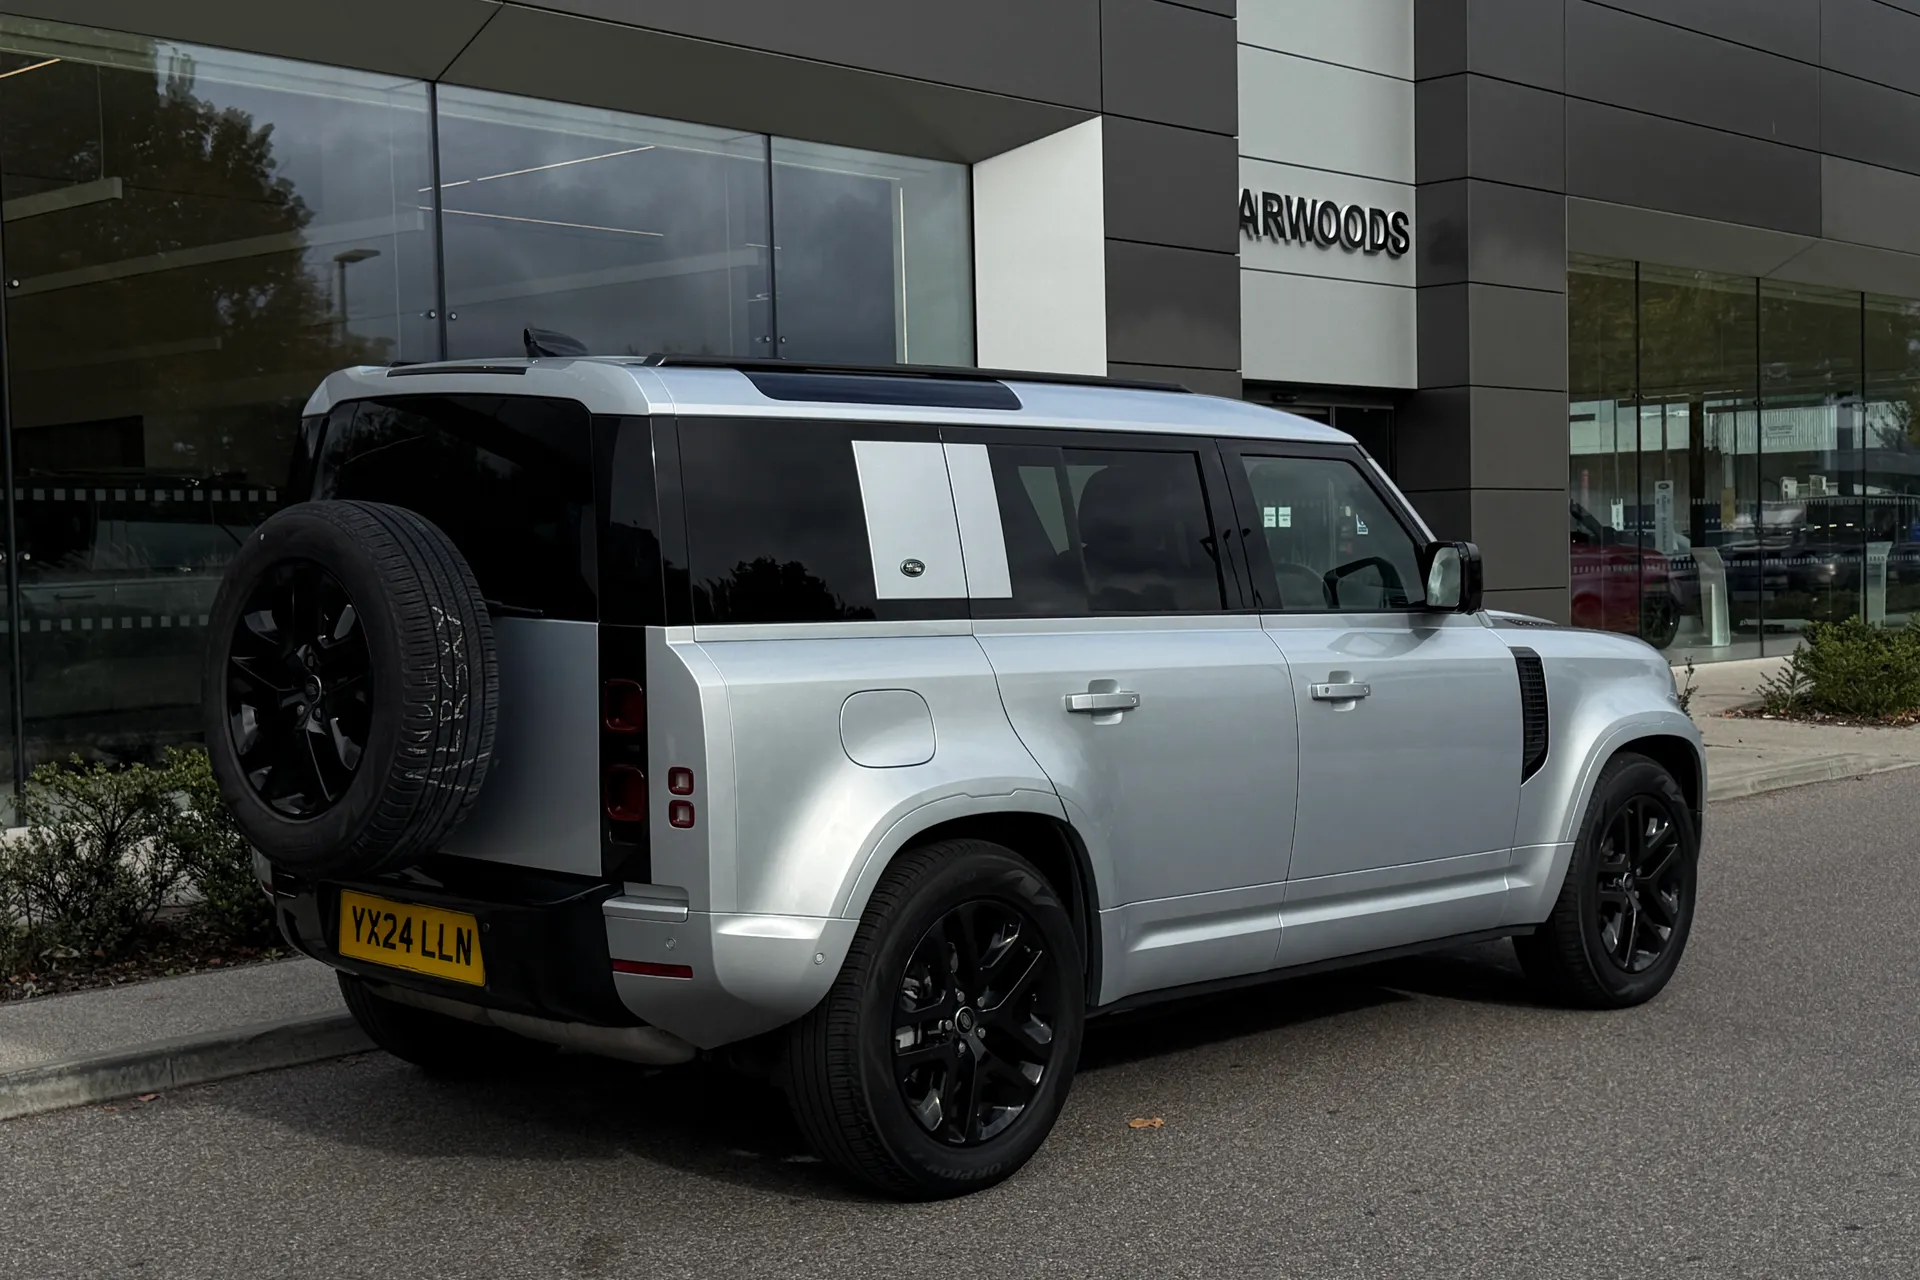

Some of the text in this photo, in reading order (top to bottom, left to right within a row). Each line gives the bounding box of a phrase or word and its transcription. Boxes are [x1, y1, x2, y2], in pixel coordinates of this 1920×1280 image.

[1239, 188, 1410, 256] ARWOODS
[352, 905, 472, 966] YX24 LLN
